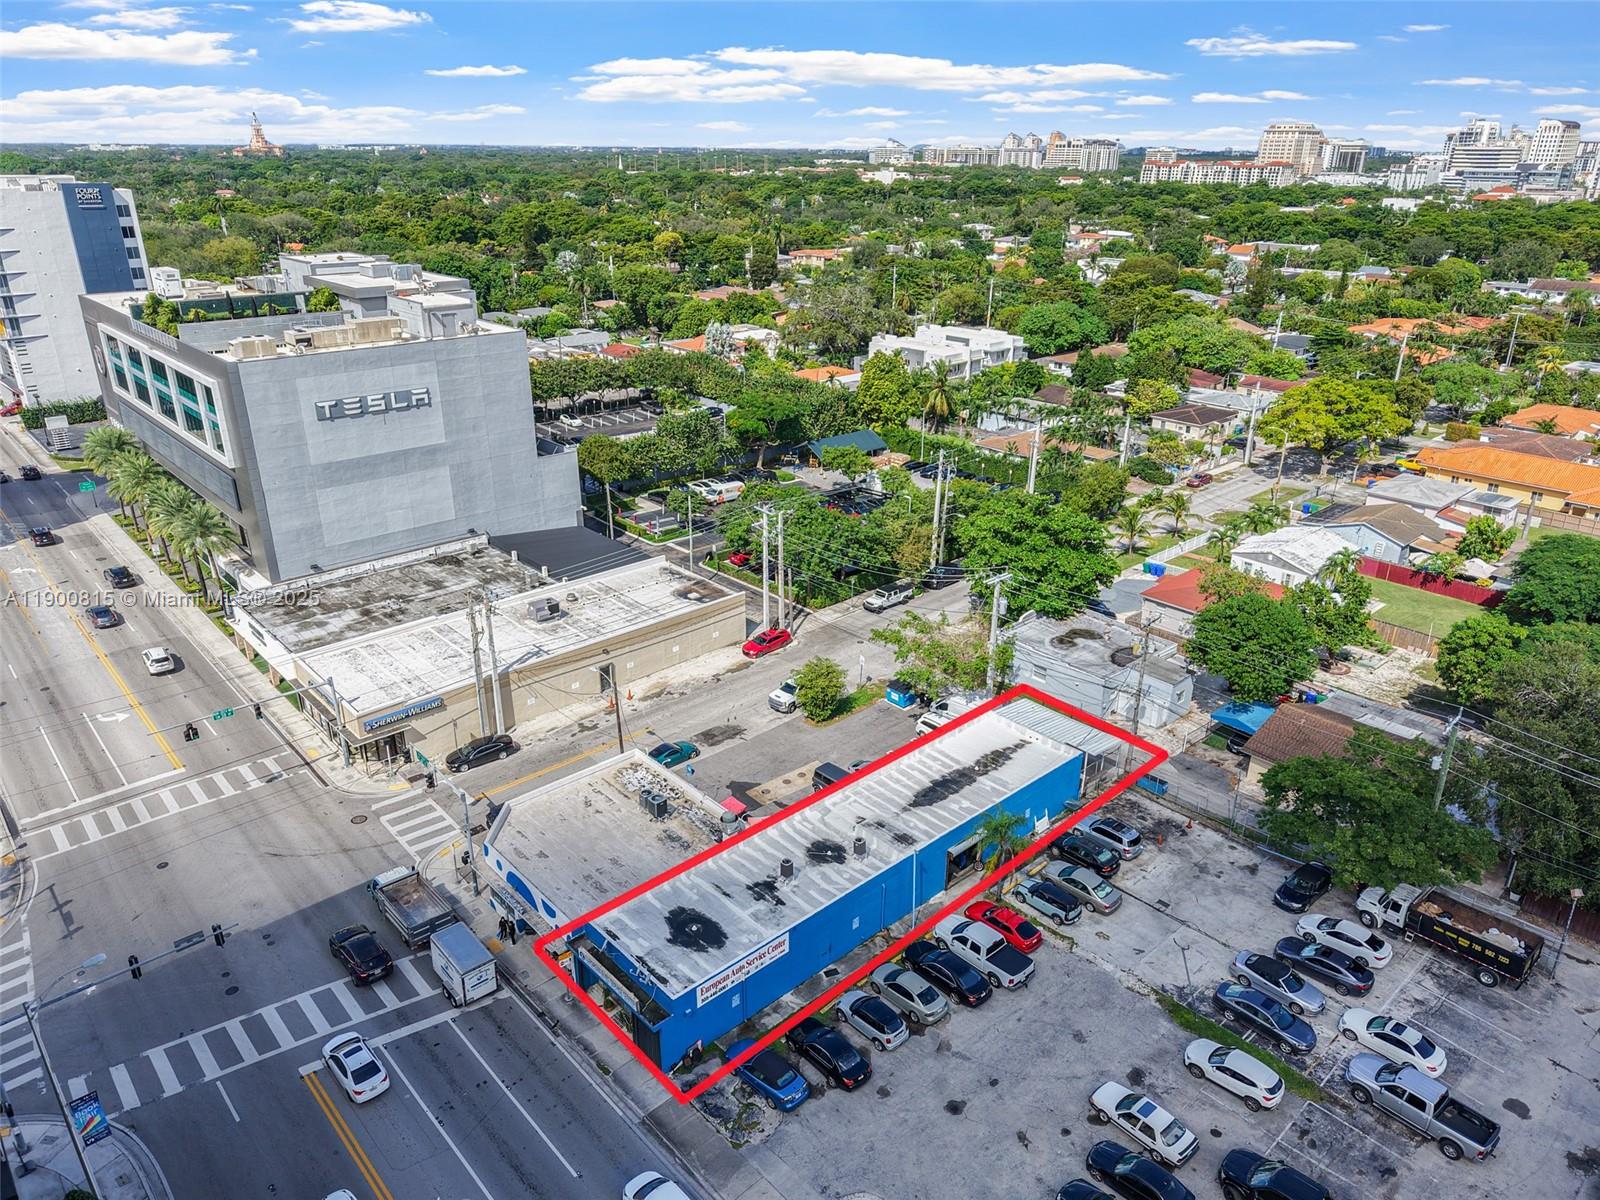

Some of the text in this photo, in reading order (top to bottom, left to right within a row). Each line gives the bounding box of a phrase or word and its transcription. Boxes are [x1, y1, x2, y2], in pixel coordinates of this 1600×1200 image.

[315, 387, 429, 418] TESLA
[700, 974, 730, 996] European
[730, 965, 745, 978] Auto
[745, 952, 766, 968] Service
[767, 940, 786, 955] Center
